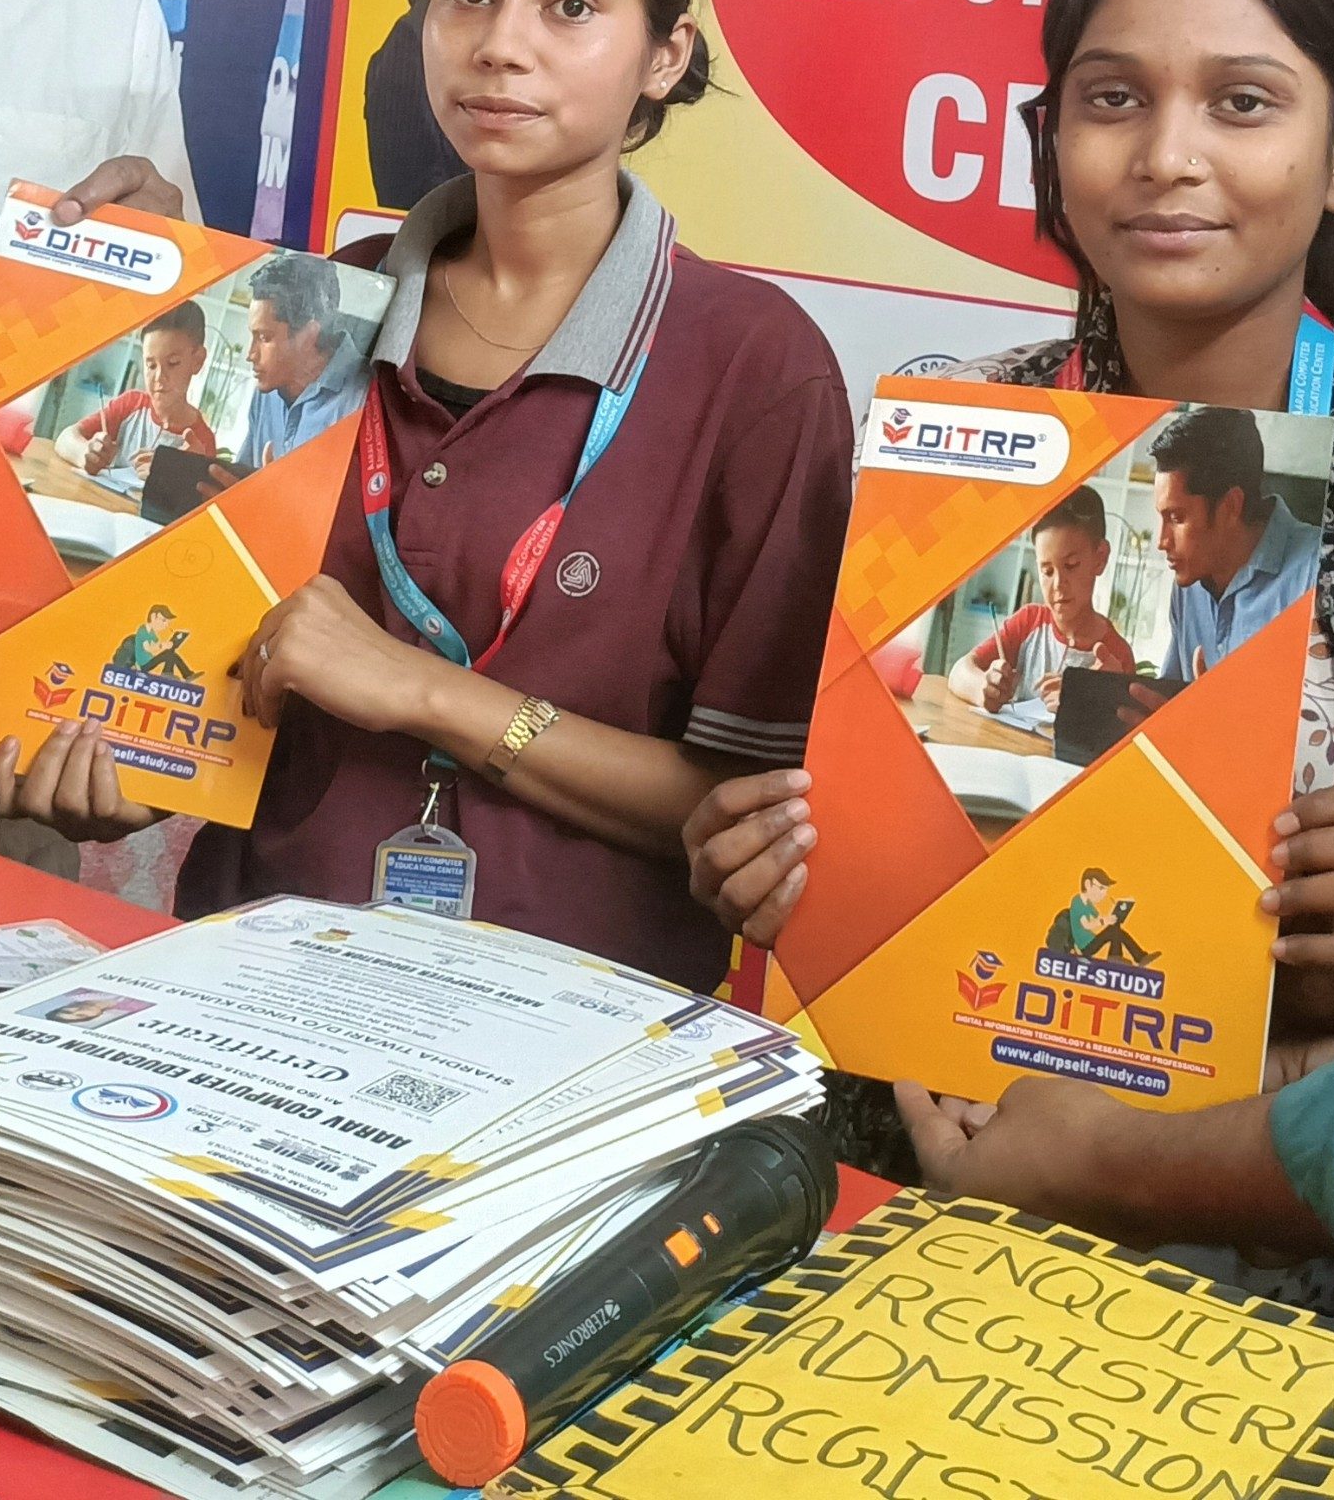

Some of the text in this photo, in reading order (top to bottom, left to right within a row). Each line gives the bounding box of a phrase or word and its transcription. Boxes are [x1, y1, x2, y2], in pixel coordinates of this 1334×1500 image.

[103, 671, 202, 705] SELF-STUDY
[112, 748, 194, 777] self-study.com
[420, 970, 496, 995] COMPUTER
[1039, 958, 1162, 998] SELF-STUDY
[97, 972, 516, 1087] SHARDHA TIWARI D/O VINOD KUMAR TIWARI
[138, 1019, 349, 1082] Certificate
[955, 1014, 983, 1028] DIGITAL
[984, 1020, 1034, 1038] INFORMATION
[1035, 1030, 1085, 1049] TECHNOLOGY
[1093, 1043, 1134, 1059] RESEARCH
[1135, 1052, 1151, 1063] FOR
[1152, 1055, 1212, 1076] PROFESSIONAL
[57, 1039, 191, 1080] EDUCATION
[996, 1043, 1167, 1091] www.ditrpself-study.com
[187, 1072, 324, 1120] COMPUTER
[320, 1115, 413, 1150] AARAV
[543, 1308, 611, 1369] ZEBRONICS
[855, 1273, 1297, 1453] REGISTER
[764, 1314, 1265, 1500] ADMISSION
